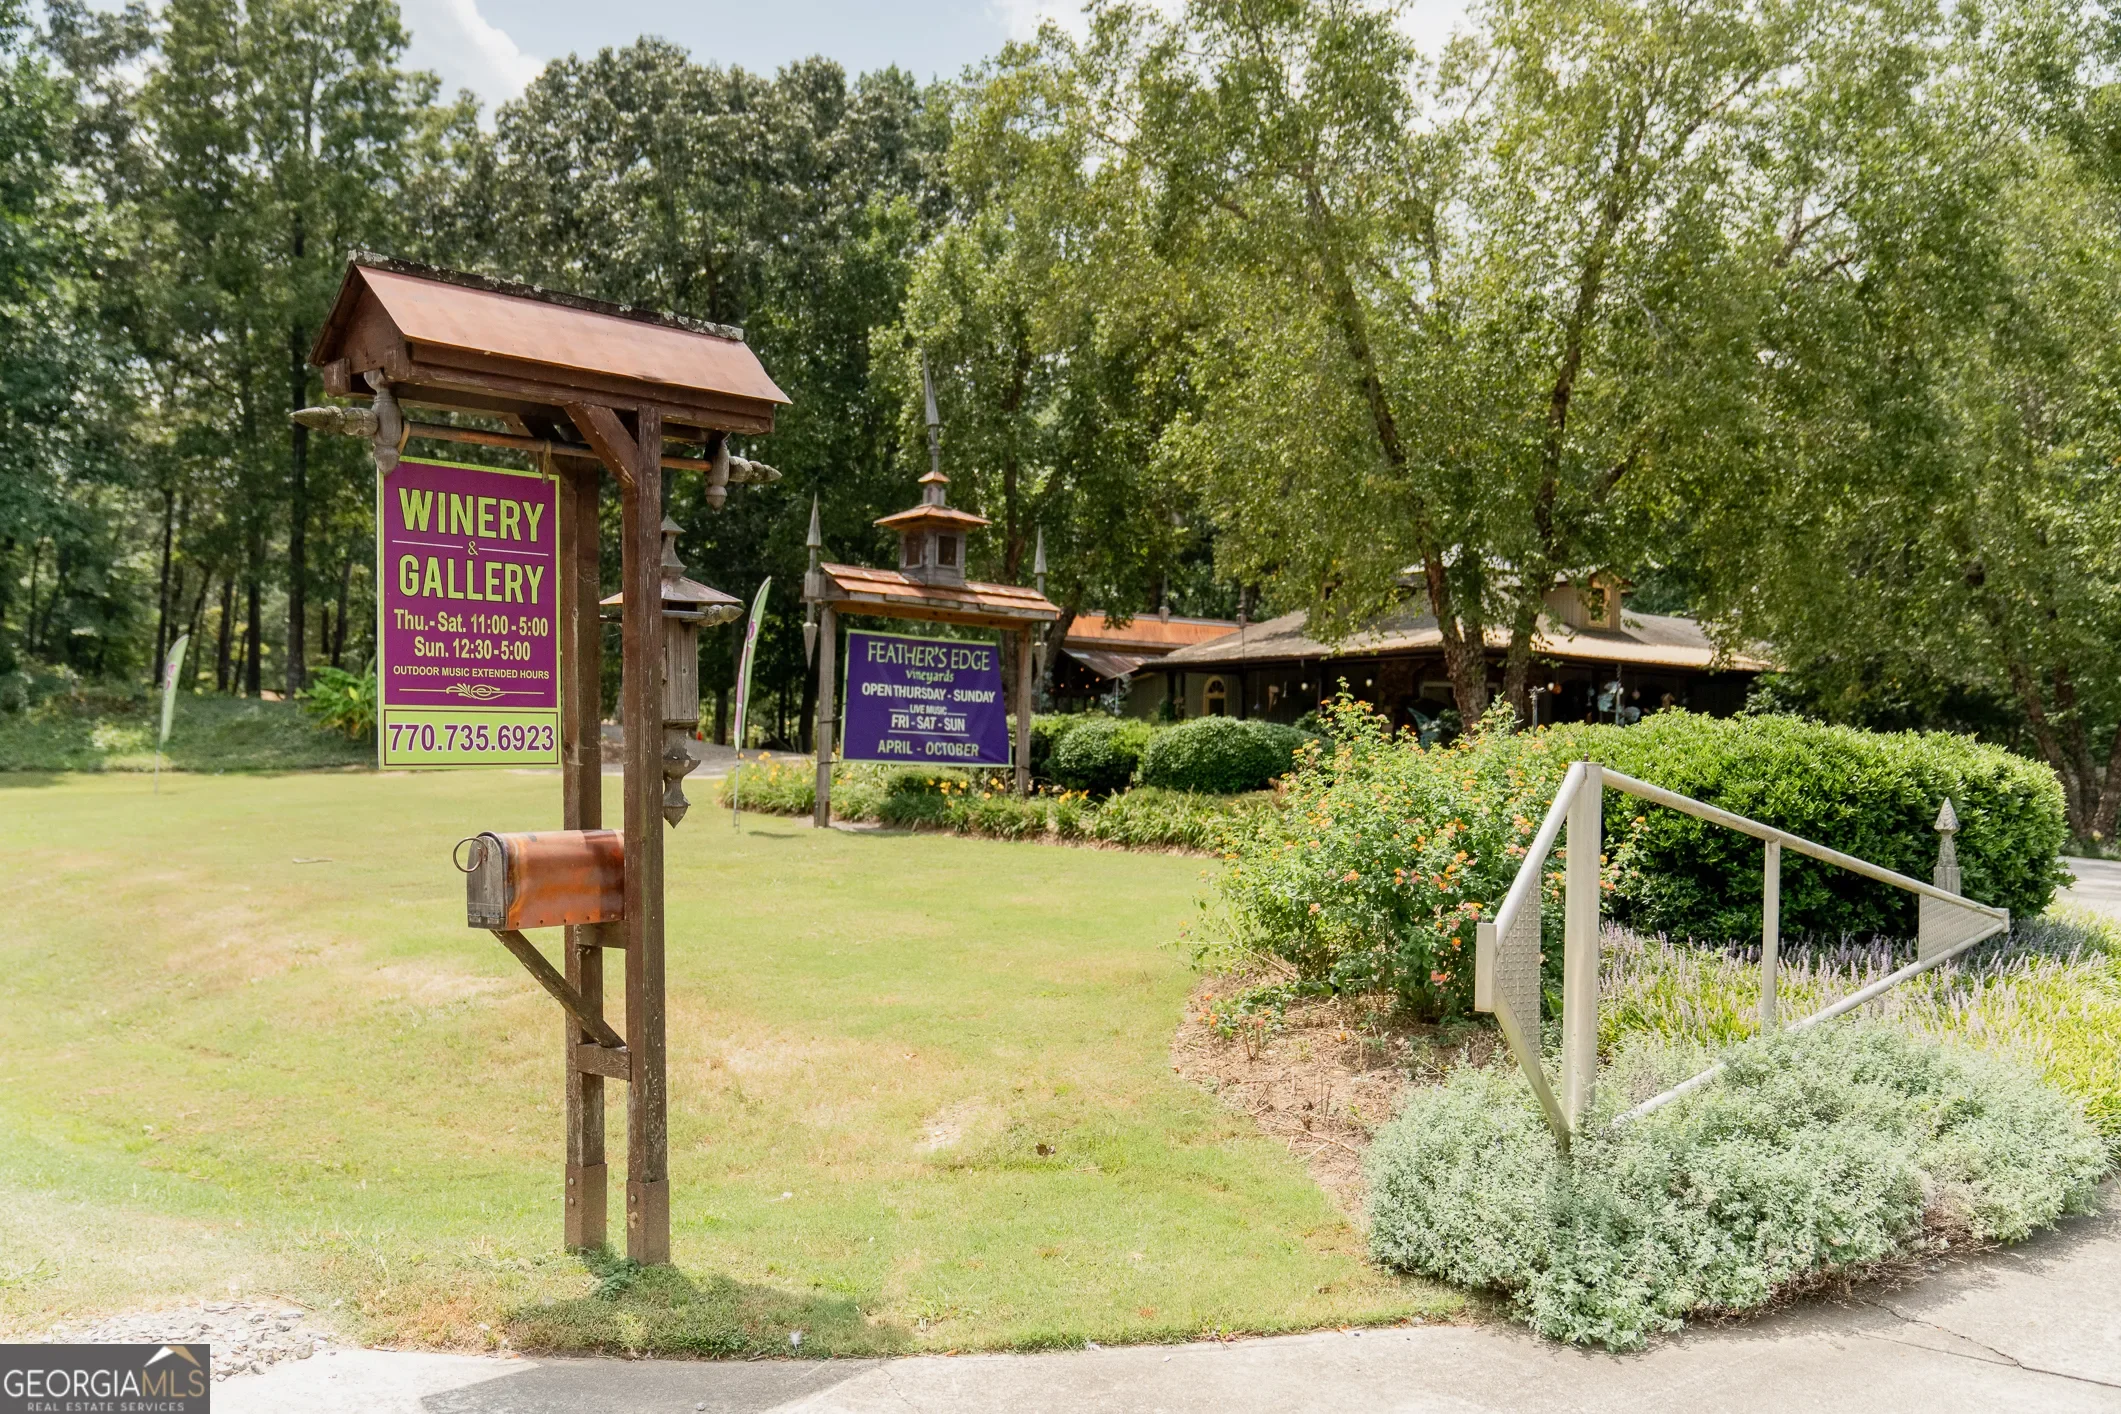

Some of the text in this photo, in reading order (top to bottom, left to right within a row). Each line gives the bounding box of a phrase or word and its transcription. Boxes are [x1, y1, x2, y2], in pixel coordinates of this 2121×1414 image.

[398, 487, 545, 542] WINERY
[467, 540, 478, 556] &
[399, 554, 544, 604] GALLERY
[414, 636, 448, 657] Sun.
[868, 641, 991, 670] FEATHER'S EDGE
[394, 665, 549, 680] OUTDOOR MUSIC EXTENDED HOURS
[906, 668, 954, 684] vineyards
[862, 683, 892, 696] OPEN
[893, 685, 946, 700] THURSDAY
[953, 690, 995, 703] SUNDAY
[910, 704, 947, 715] LIVE MUSIC
[891, 714, 909, 728] FRI
[917, 716, 936, 730] SAT
[944, 718, 965, 731] SUN
[388, 724, 554, 752] 770.735.6923
[877, 740, 913, 754] APRIL
[925, 742, 979, 756] OCTOBER
